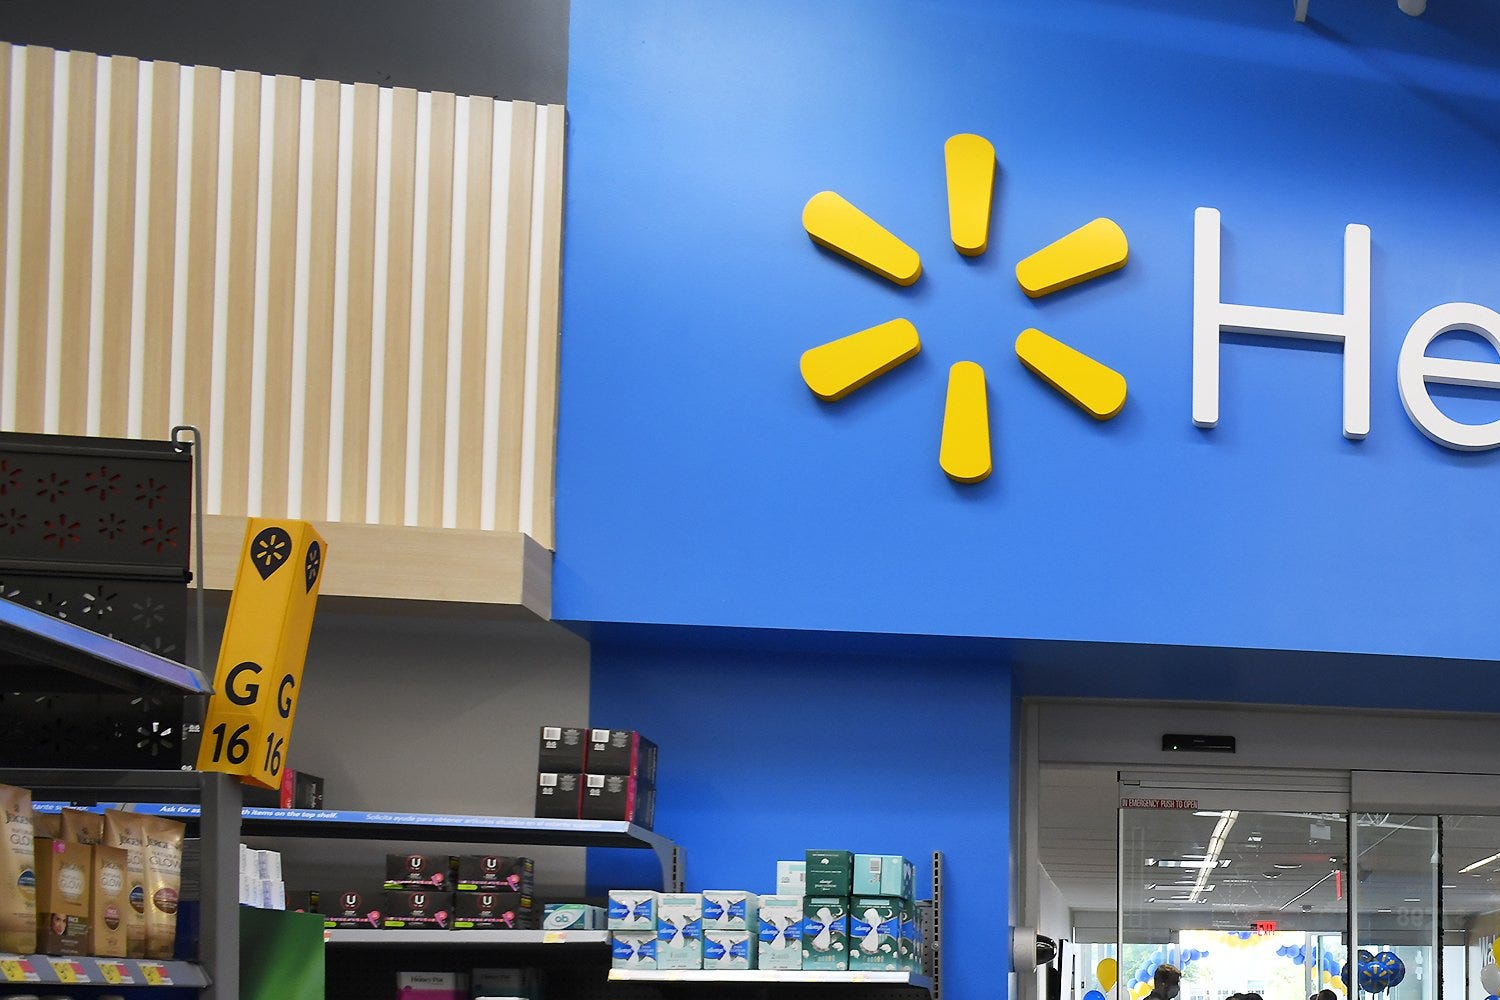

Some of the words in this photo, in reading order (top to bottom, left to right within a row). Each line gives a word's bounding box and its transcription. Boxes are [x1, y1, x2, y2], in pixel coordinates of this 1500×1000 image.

[225, 661, 262, 705] G
[278, 674, 295, 718] G
[212, 723, 250, 765] 16
[263, 732, 282, 776] 16
[1129, 799, 1159, 808] EMERGENCY
[1161, 800, 1175, 808] PUSH
[1176, 800, 1183, 808] TO
[1184, 800, 1198, 809] OPEN
